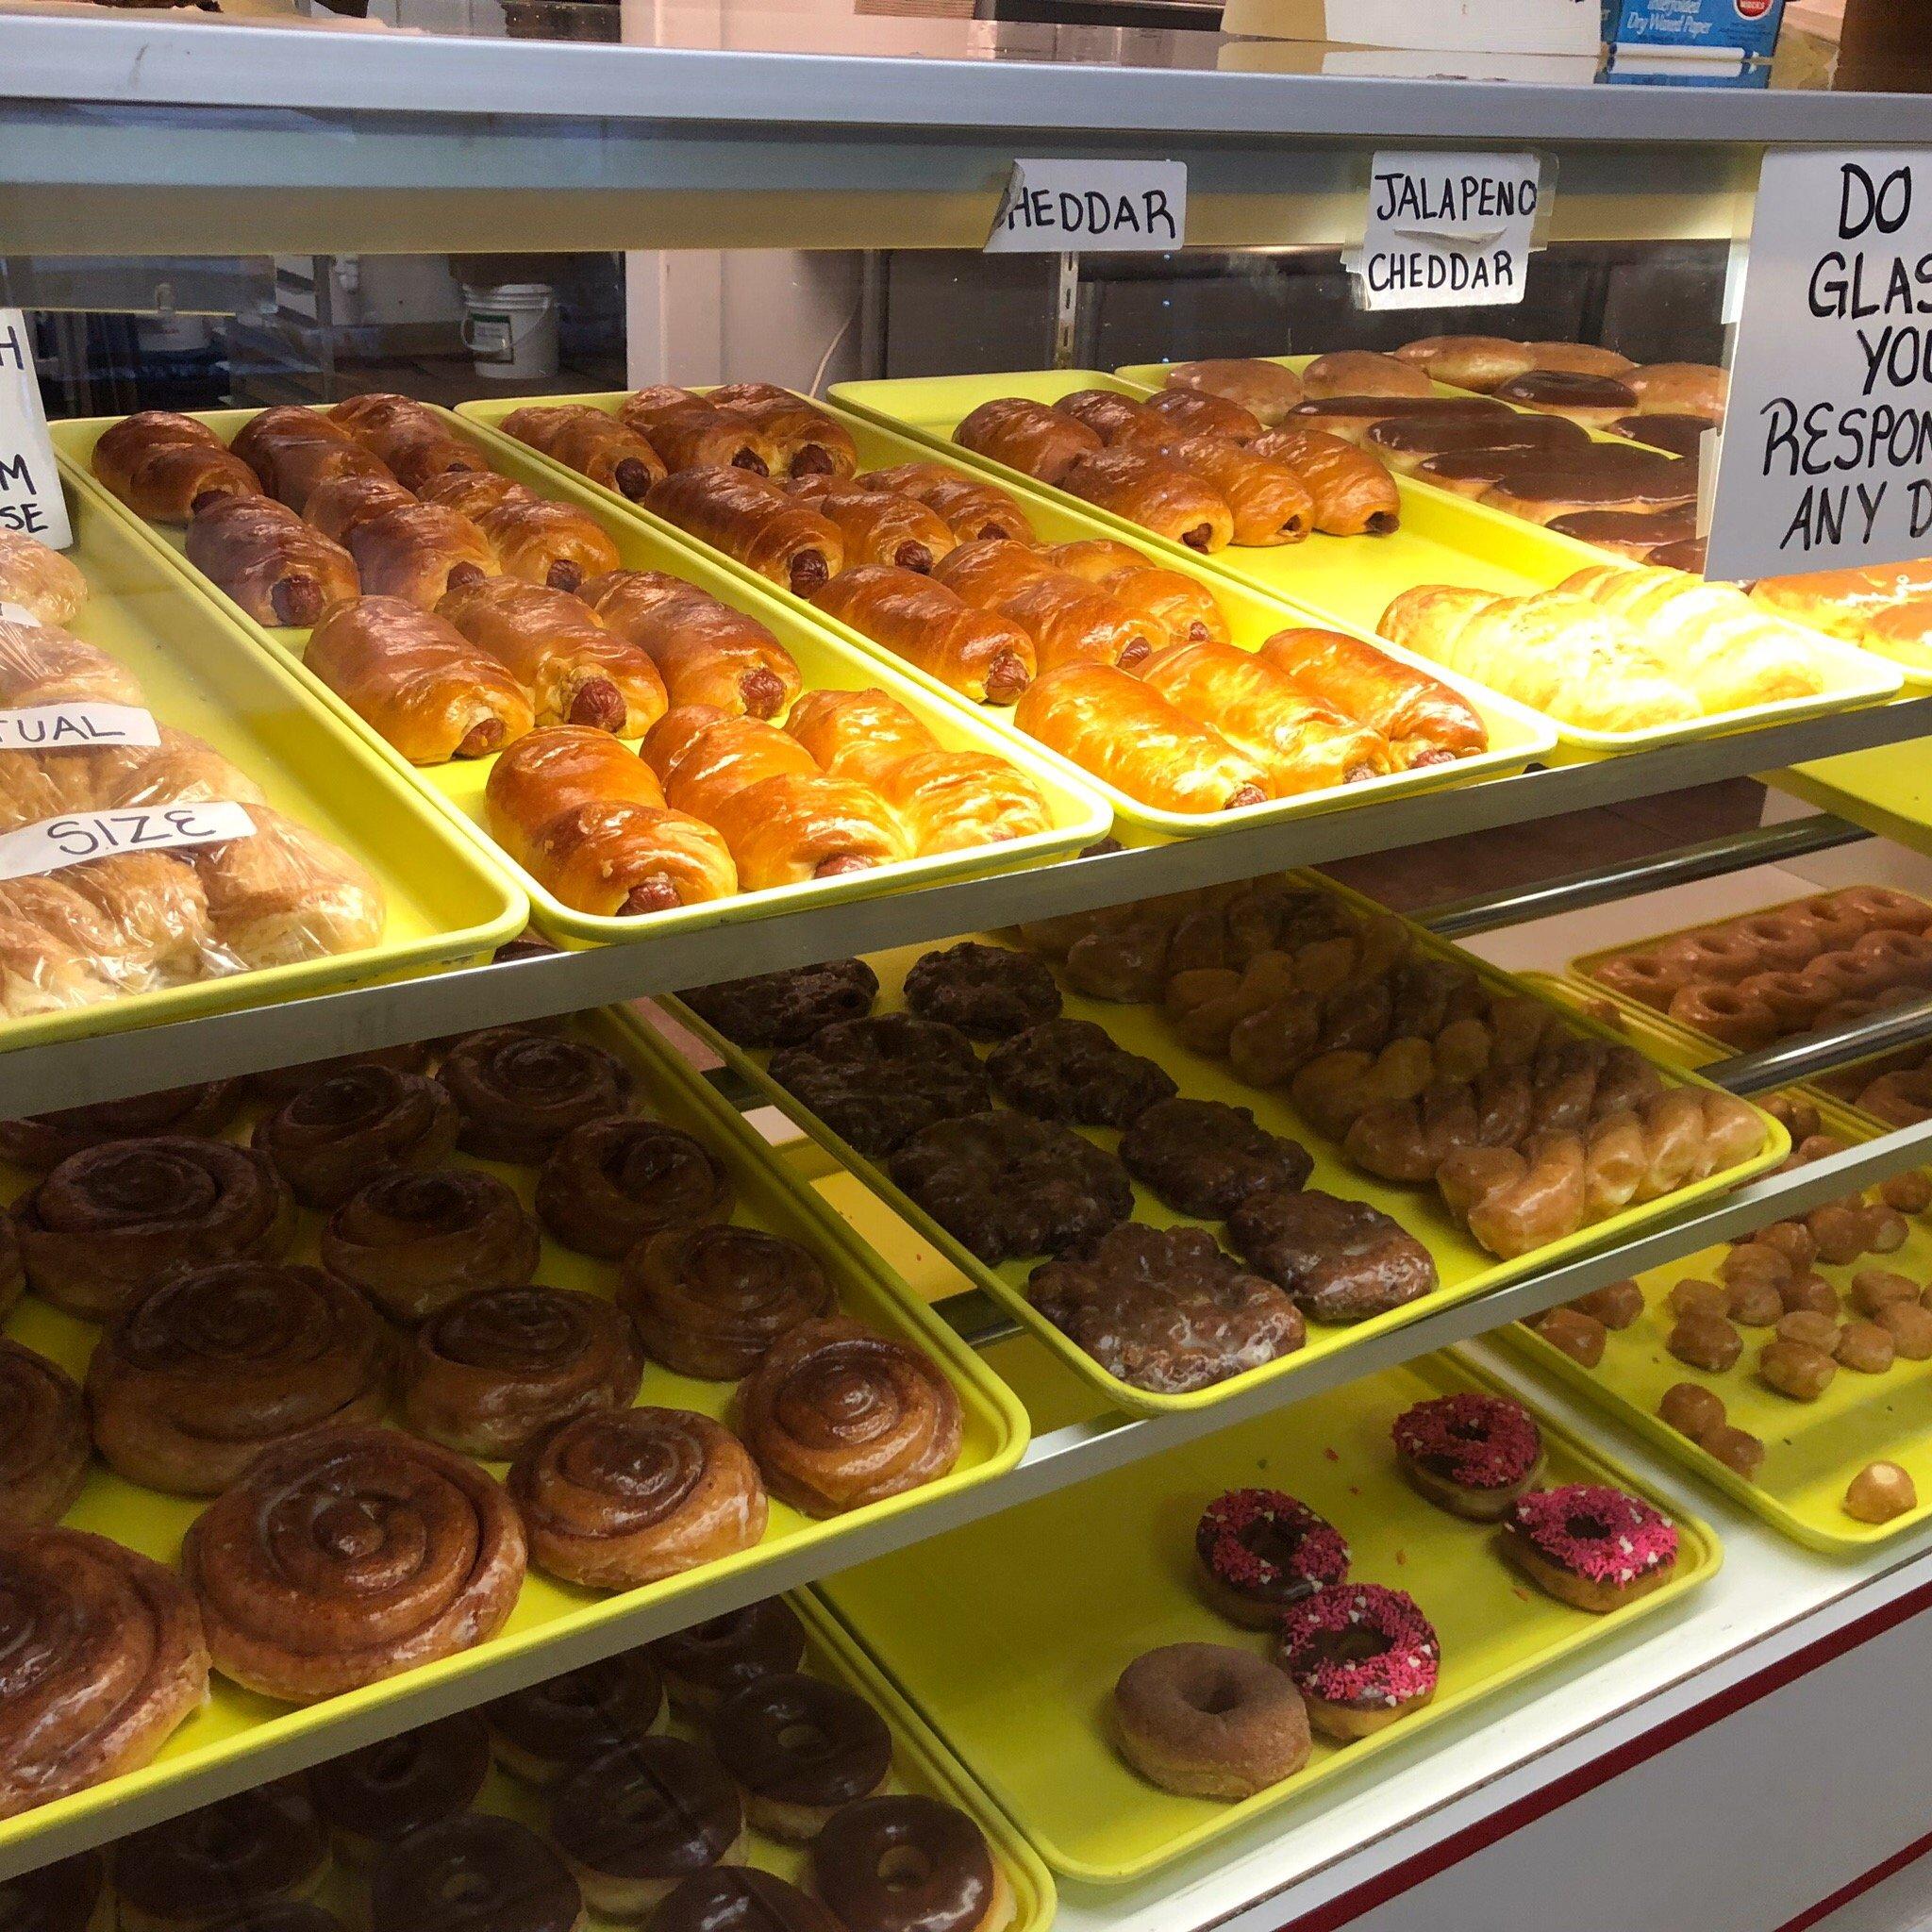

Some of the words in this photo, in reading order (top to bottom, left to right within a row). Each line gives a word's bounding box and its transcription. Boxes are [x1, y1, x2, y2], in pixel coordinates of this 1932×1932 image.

[998, 187, 1175, 239] HEDDAR
[1374, 173, 1538, 221] JALAPENO
[1839, 163, 1911, 240] DO
[1368, 250, 1513, 291] CHEDDAR
[1779, 481, 1887, 551] ANY
[47, 810, 216, 855] SIZE
